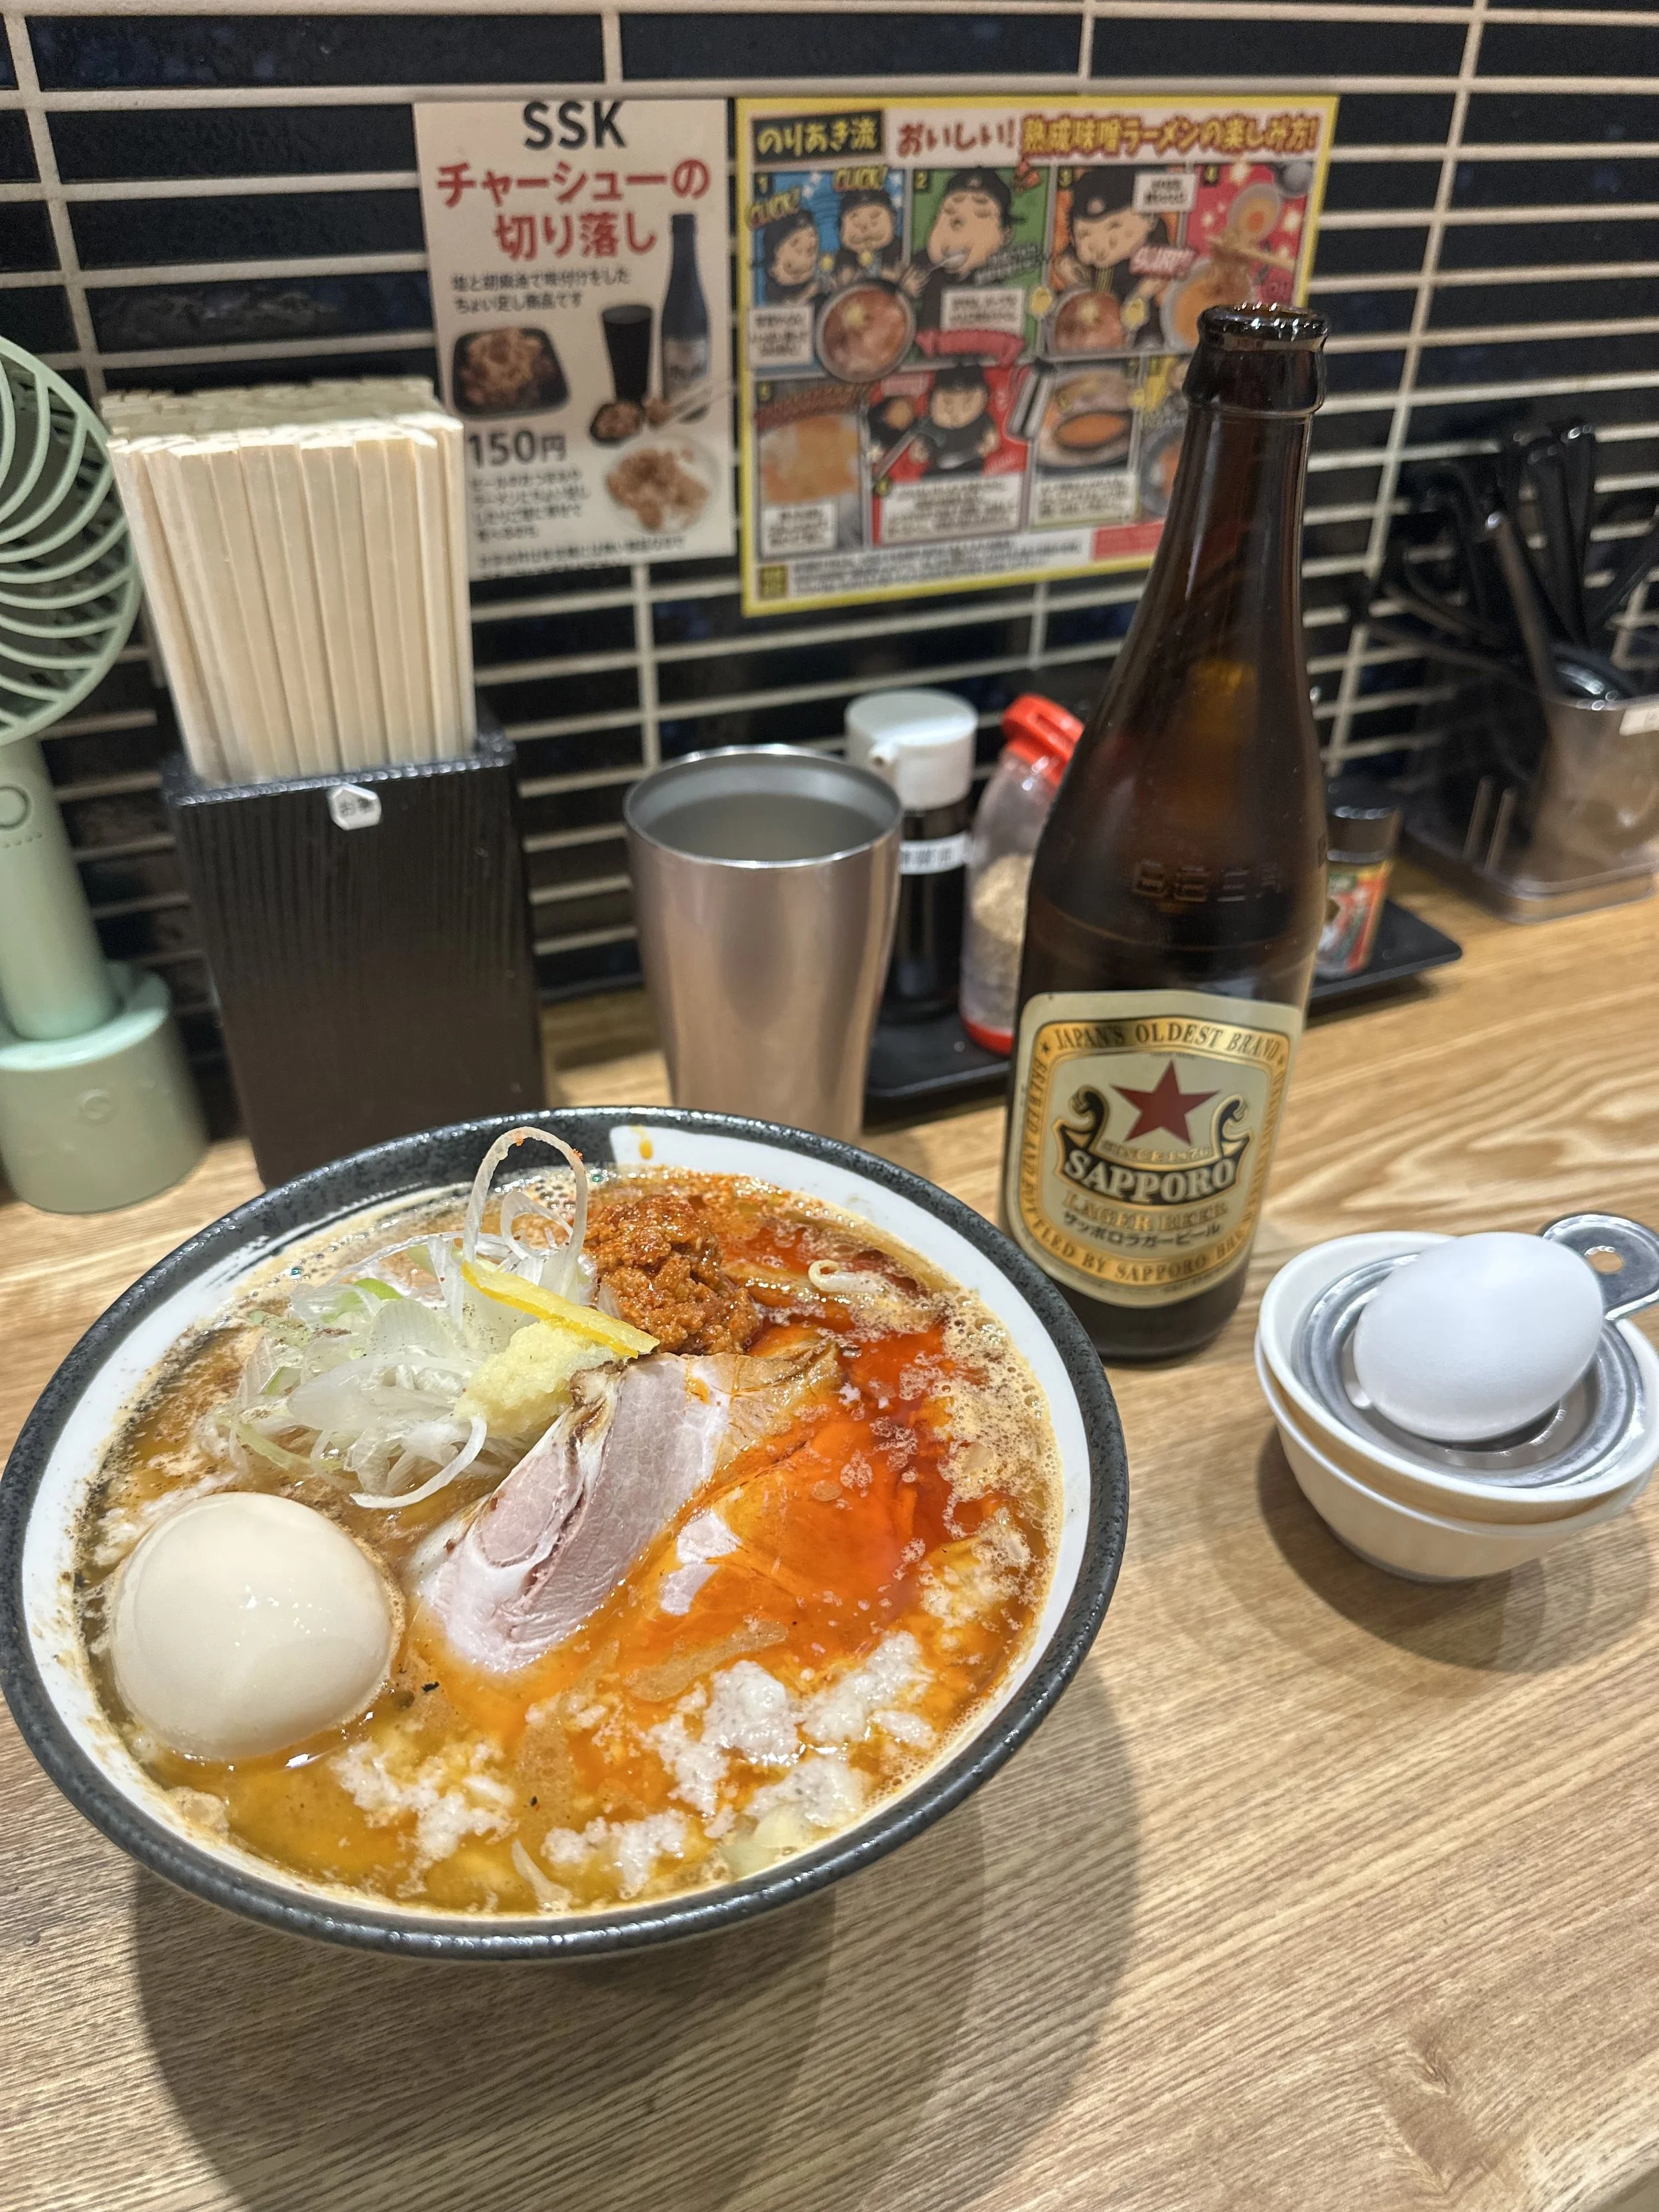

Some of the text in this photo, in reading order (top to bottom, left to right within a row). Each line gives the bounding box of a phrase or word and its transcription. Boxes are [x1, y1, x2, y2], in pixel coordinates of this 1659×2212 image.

[522, 100, 626, 149] SSK
[757, 118, 877, 155] のりあき流
[437, 159, 711, 207] チャーシューの
[494, 212, 658, 261] 切り落し
[468, 429, 567, 469] 150円
[1053, 1021, 1281, 1061] JAPAN'S OLDEST BRAND
[1063, 1149, 1237, 1204] SAPPORO
[1063, 1191, 1228, 1232] LAGER BEER
[1063, 1211, 1221, 1248] サッポロラガービール
[1081, 1251, 1106, 1273] BY
[1114, 1253, 1206, 1282] SAPPORO
